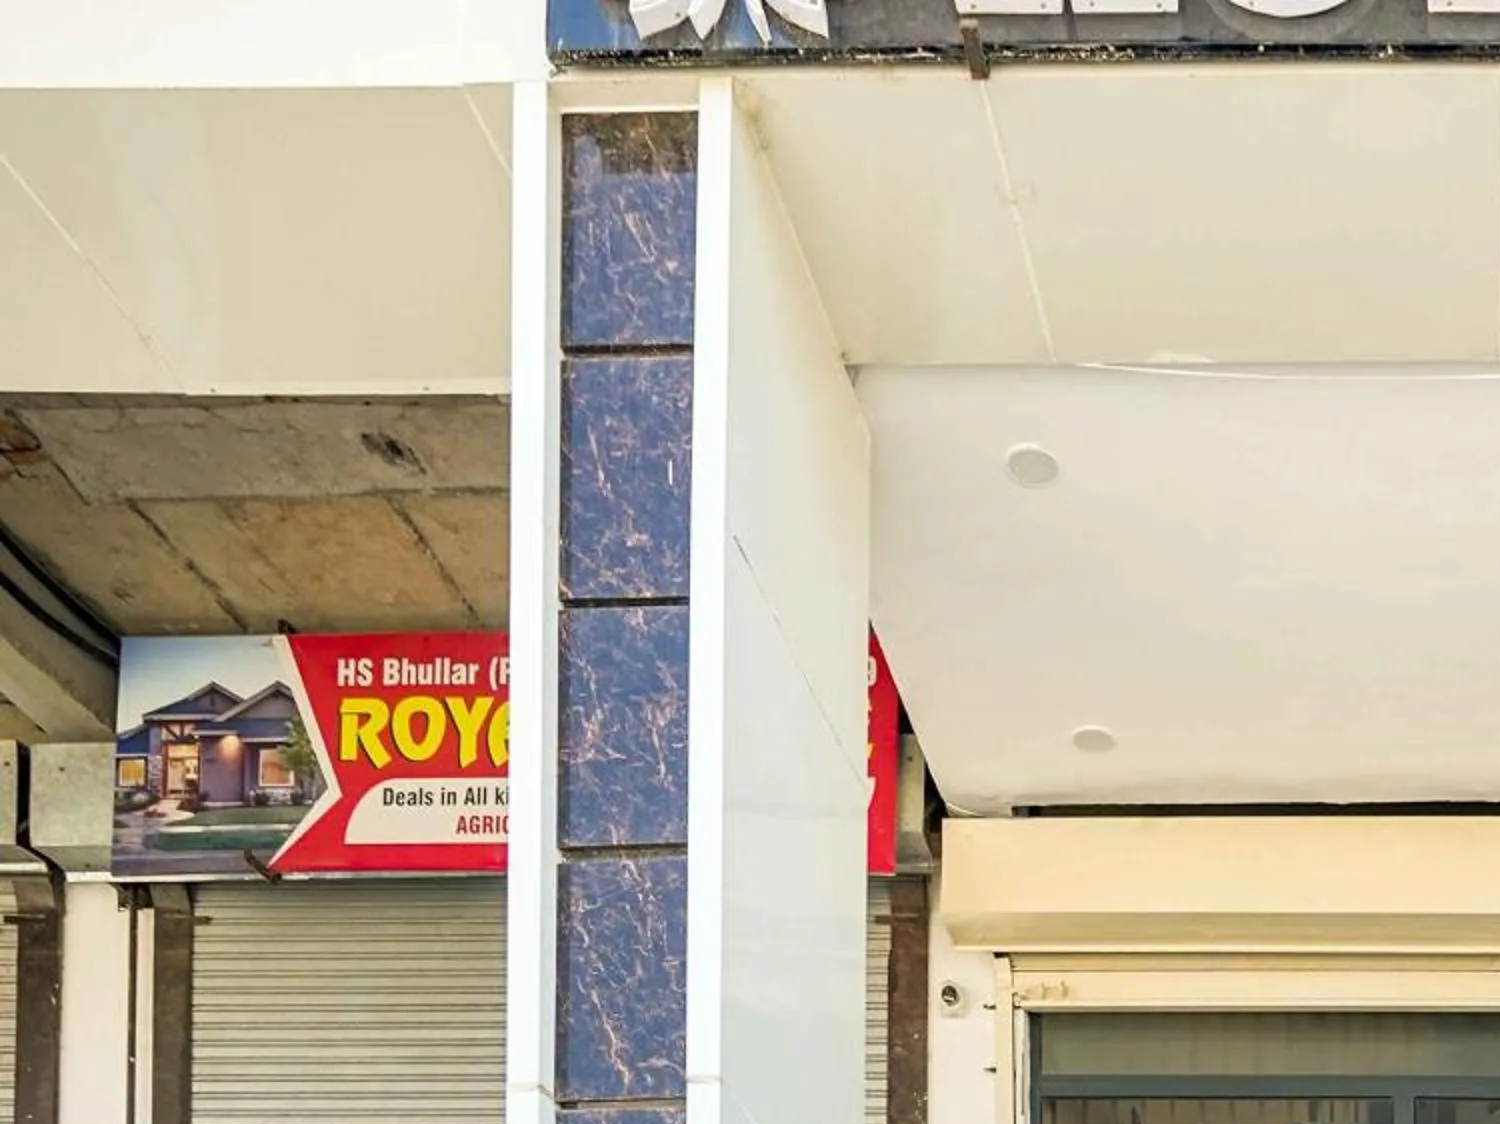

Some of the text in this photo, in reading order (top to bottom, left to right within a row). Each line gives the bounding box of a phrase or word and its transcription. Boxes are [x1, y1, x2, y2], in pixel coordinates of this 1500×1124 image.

[337, 657, 374, 687] HS
[383, 656, 480, 686] Bhullar
[383, 787, 434, 806] Deals
[441, 787, 457, 806] in
[464, 786, 487, 806] All
